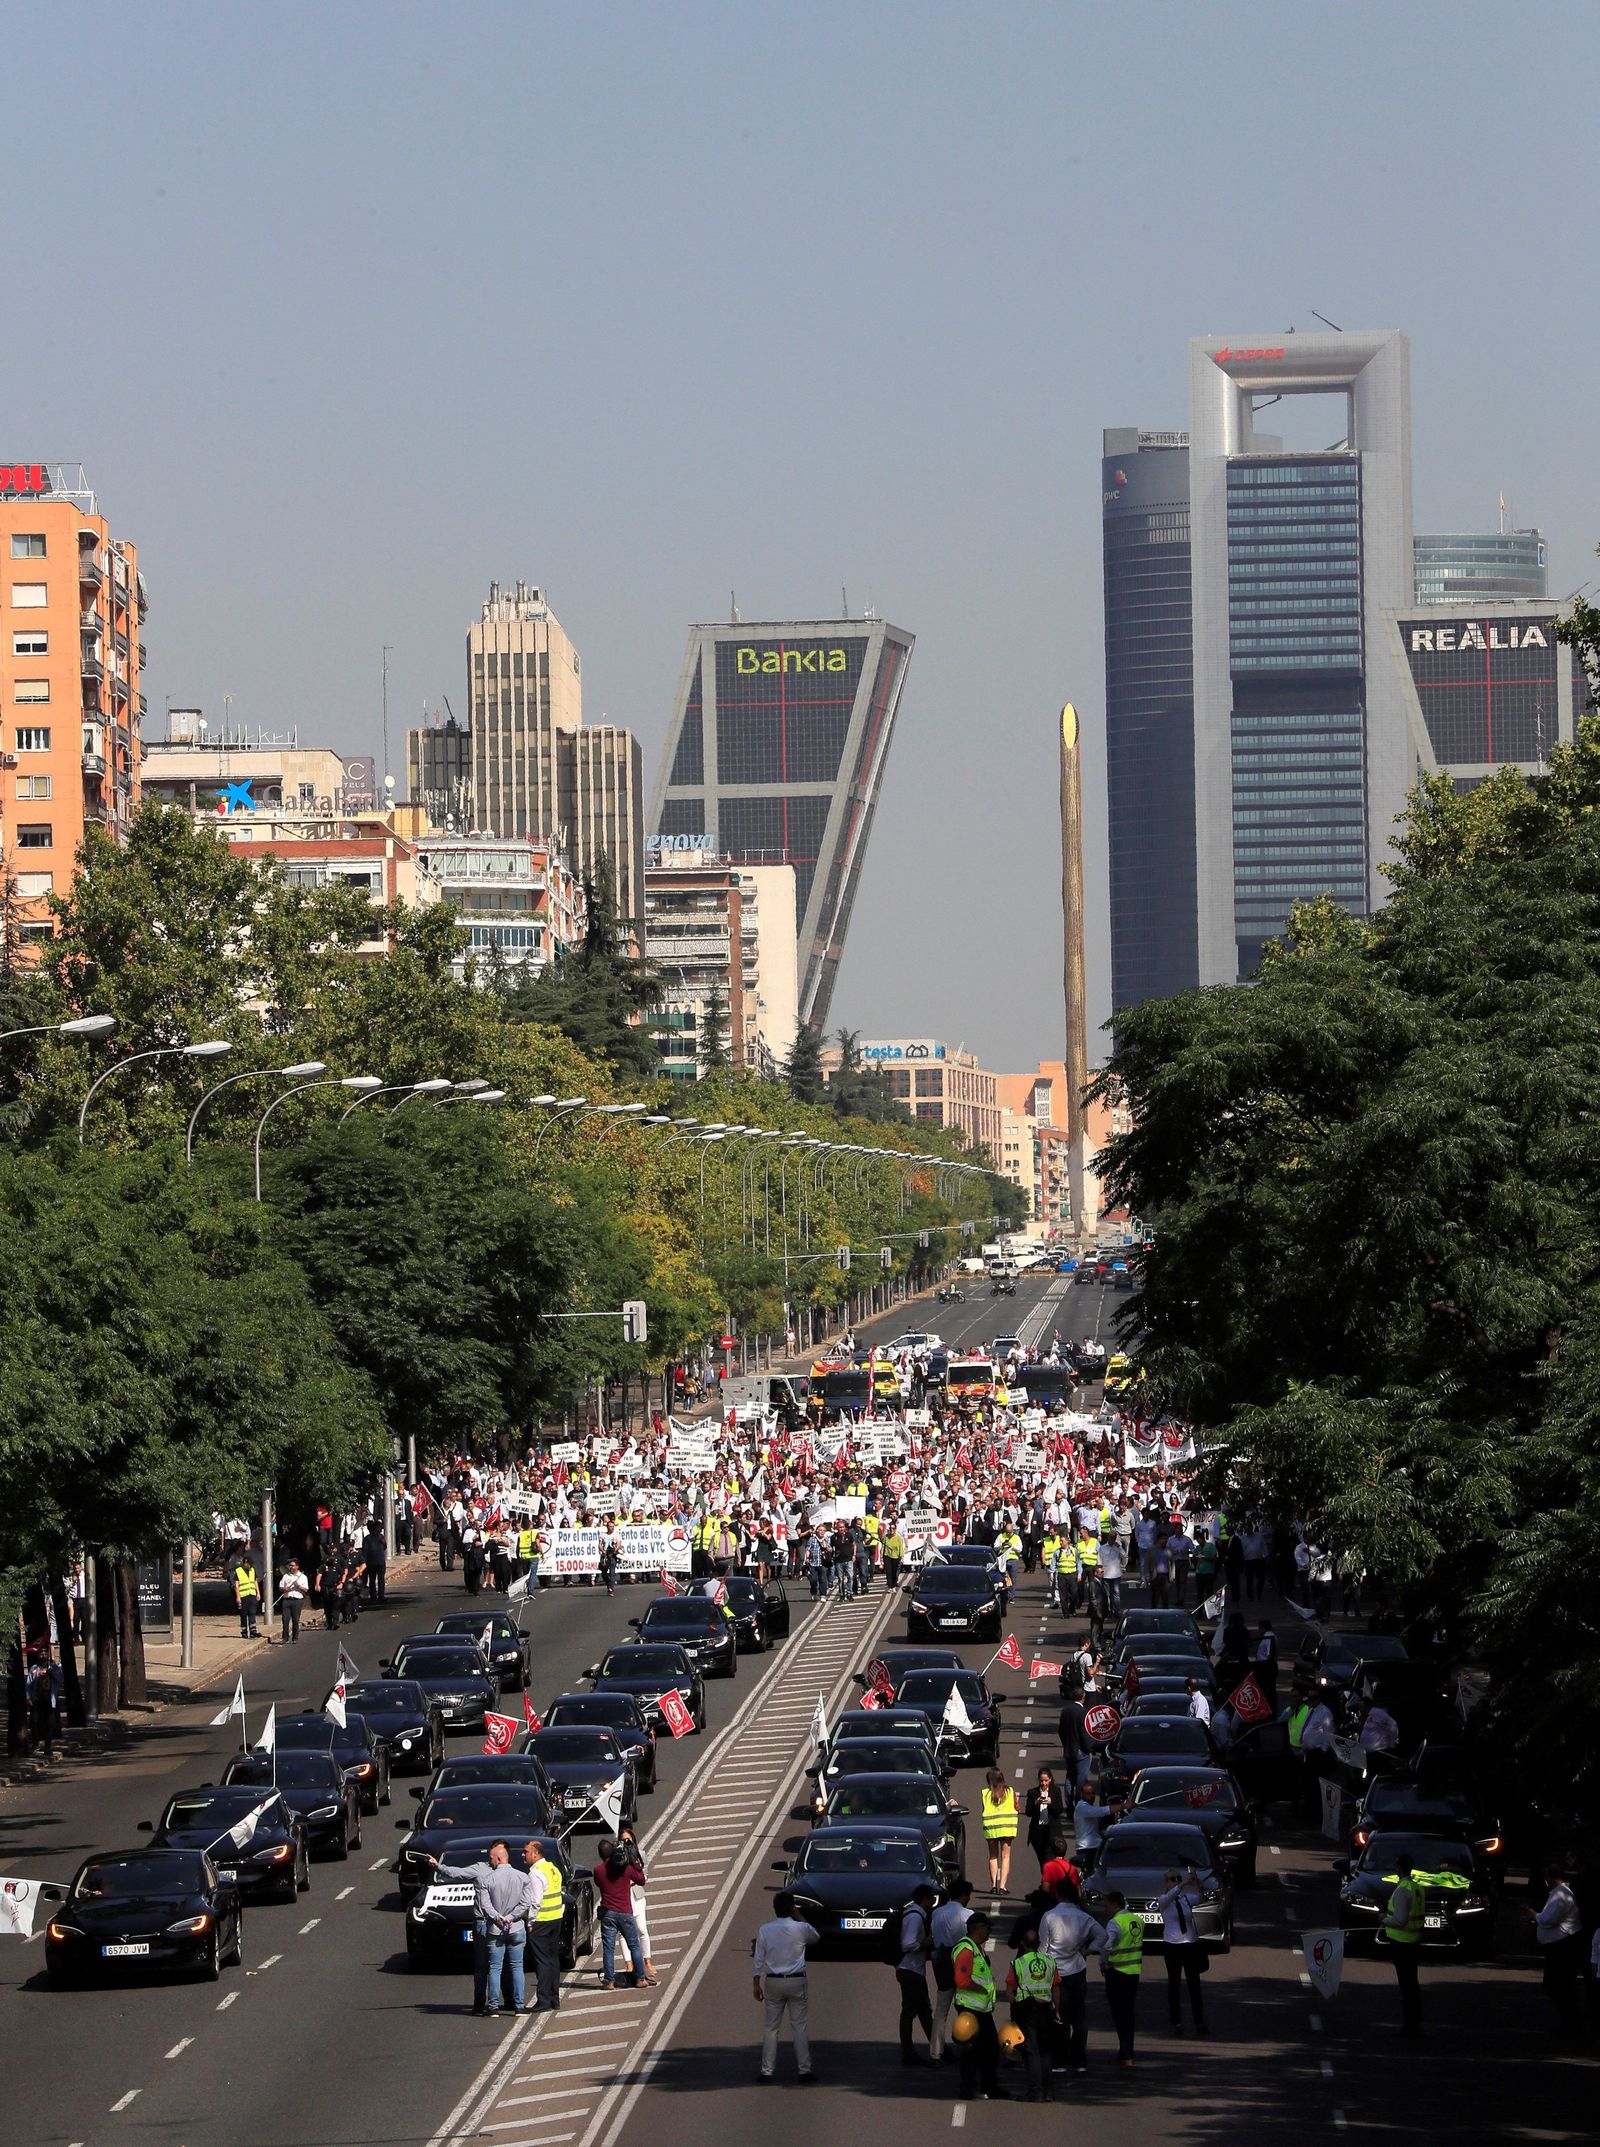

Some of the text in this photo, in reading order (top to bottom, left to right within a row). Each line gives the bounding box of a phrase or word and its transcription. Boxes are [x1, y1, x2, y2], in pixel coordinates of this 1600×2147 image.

[1103, 490, 1120, 504] pwc
[1412, 623, 1548, 651] REALIA
[737, 648, 846, 674] Bankia
[263, 784, 391, 812] CaixaBank
[865, 1044, 902, 1058] testa
[519, 1491, 533, 1499] PEDRO
[558, 1531, 571, 1542] Por
[573, 1530, 580, 1541] el
[640, 1528, 649, 1539] de
[651, 1528, 662, 1539] los
[556, 1544, 585, 1558] puestos
[586, 1544, 596, 1555] de
[627, 1543, 636, 1554] de
[638, 1542, 649, 1553] las
[650, 1542, 665, 1553] VTC
[555, 1560, 584, 1572] 15.000
[636, 1560, 643, 1569] EN
[644, 1560, 651, 1568] LA
[653, 1560, 667, 1568] CALLE
[1088, 1708, 1112, 1728] UGT
[846, 1919, 867, 1928] 6512
[108, 1944, 148, 1956] 6570 JVM
